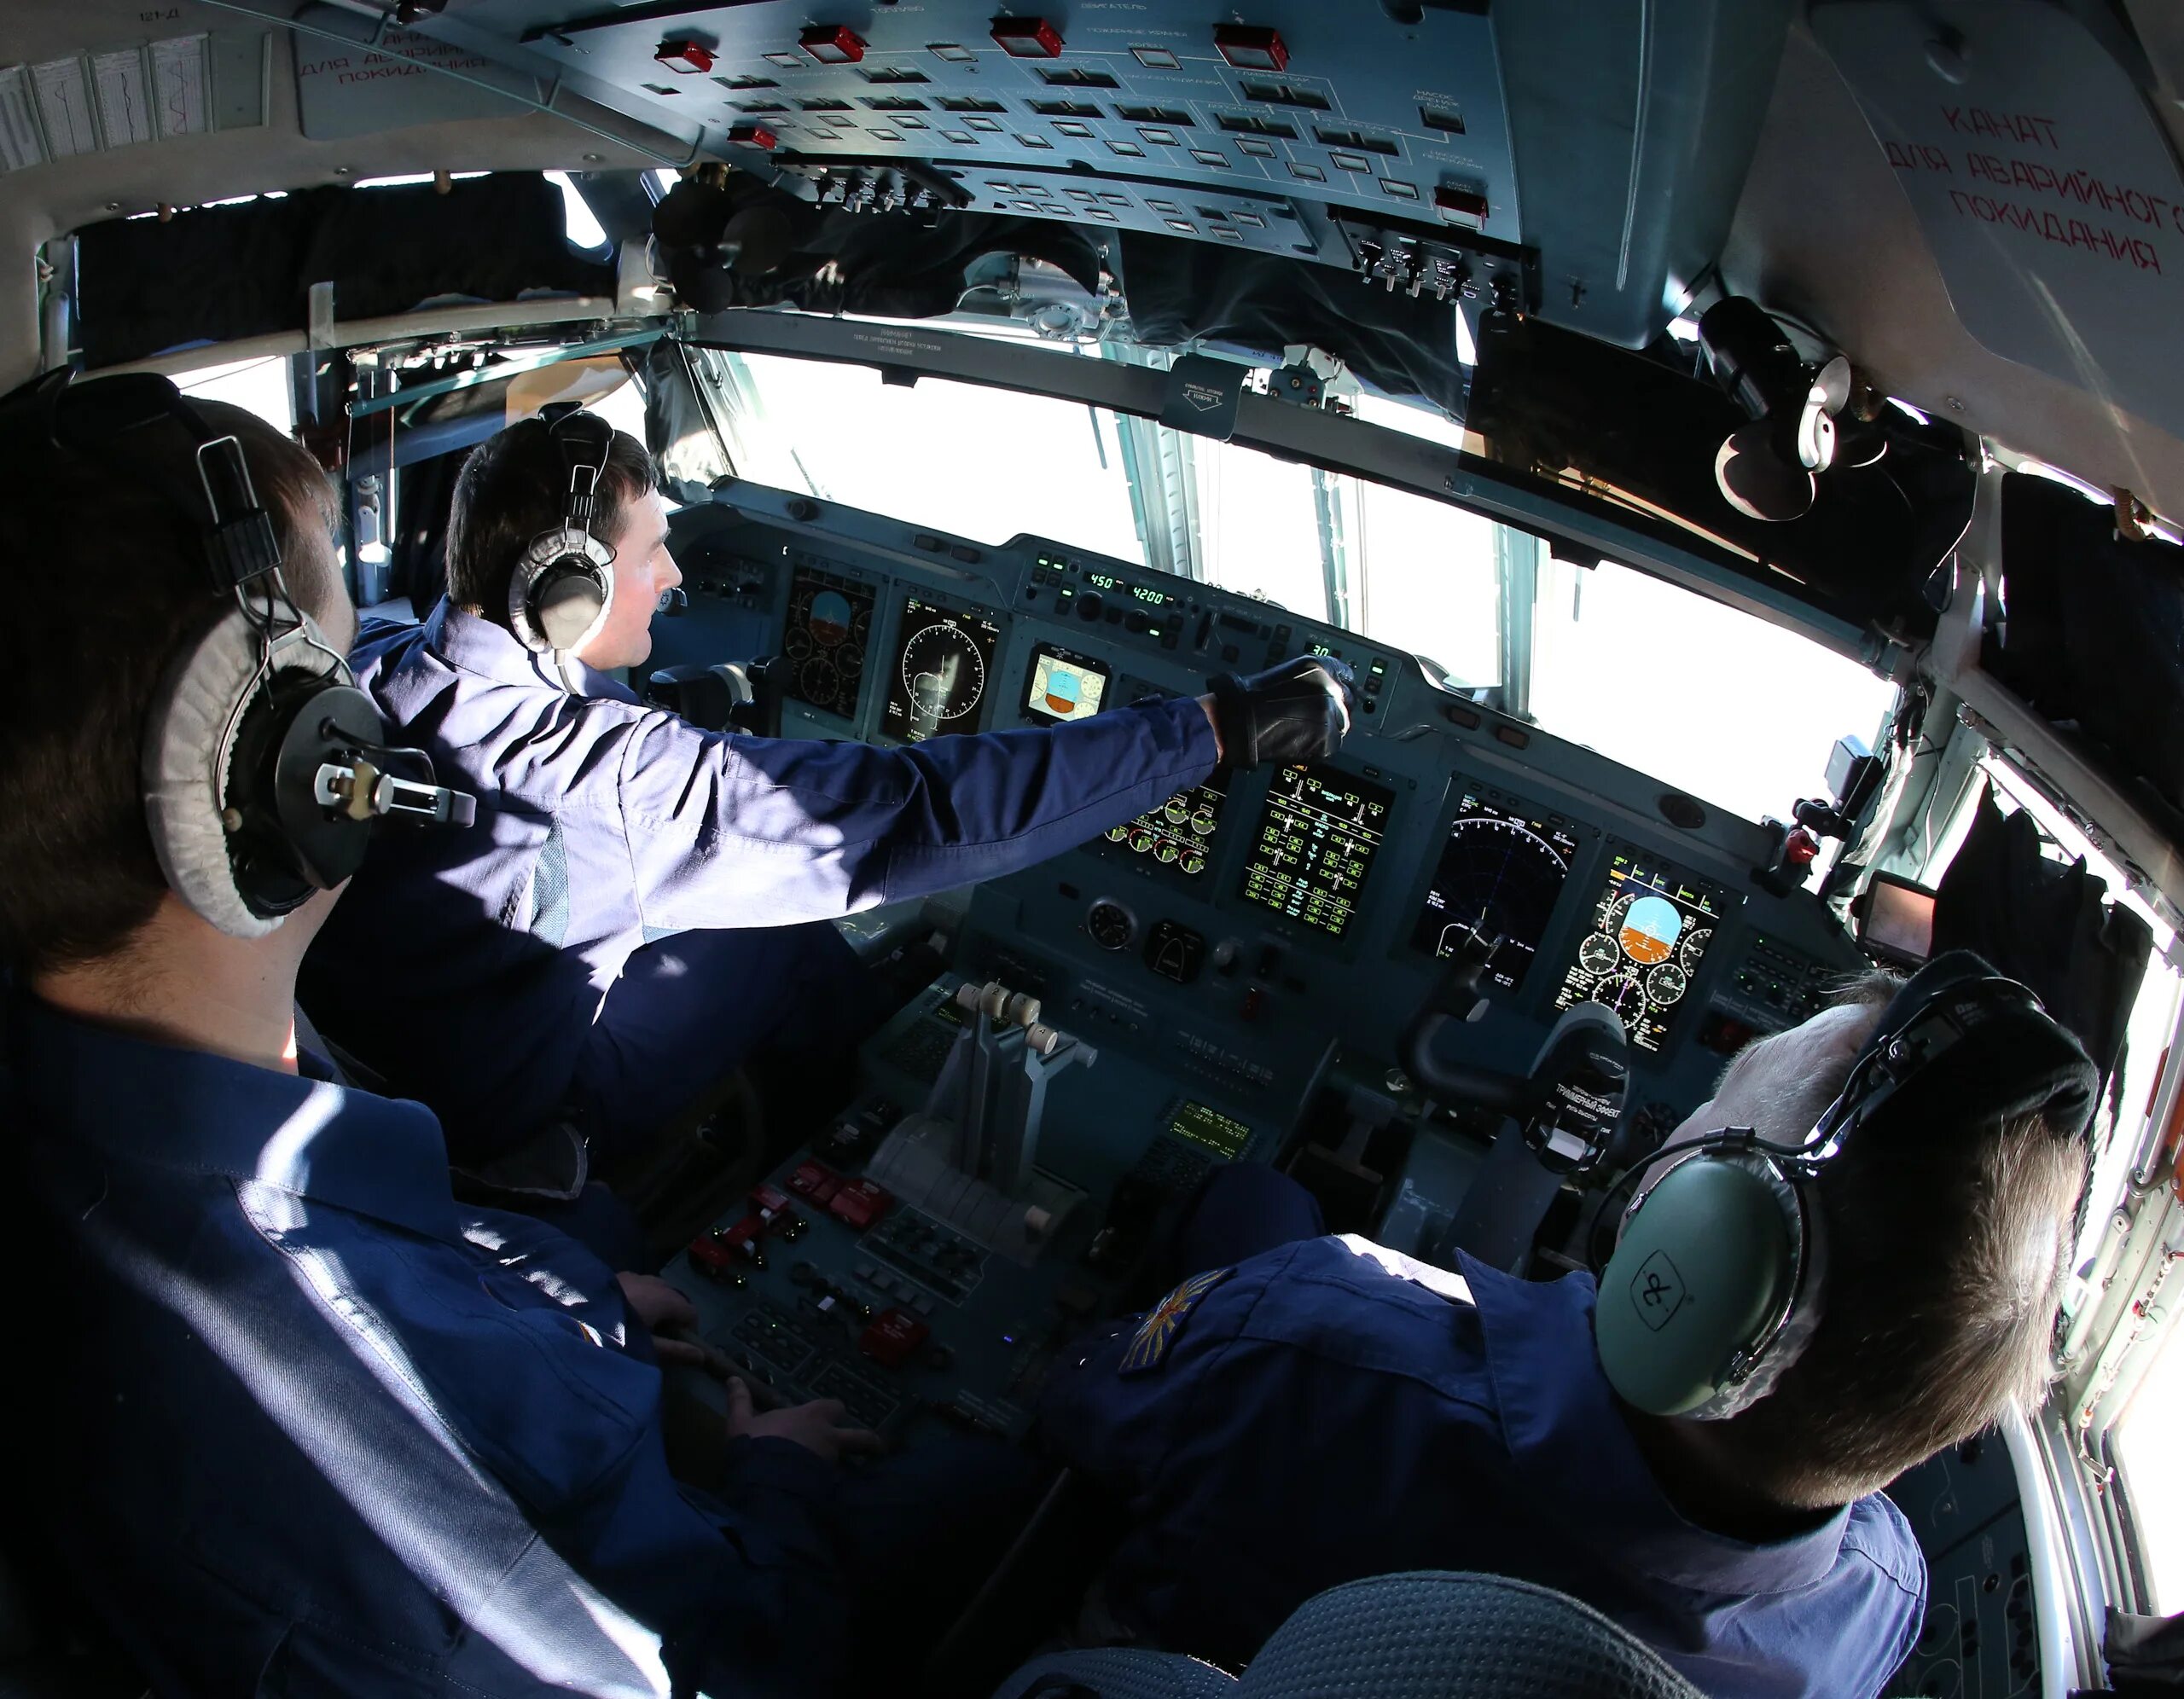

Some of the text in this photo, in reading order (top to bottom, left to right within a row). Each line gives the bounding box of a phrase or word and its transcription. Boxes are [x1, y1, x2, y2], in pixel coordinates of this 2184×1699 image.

[300, 57, 349, 77] ДЛЯ
[1942, 106, 2059, 151] КАНАТ
[1885, 141, 1953, 174] ДЛЯ
[1949, 189, 2162, 275] ПОКИДАНИЯ
[1091, 574, 1112, 589] 450
[1133, 587, 1164, 605] 4200
[1312, 644, 1329, 658] 30
[1556, 1083, 1596, 1110] ТРИММЕРНЫЙ
[1595, 1105, 1621, 1118] ЭФФЕКТ
[1578, 1110, 1598, 1122] ВЫСОТЫ
